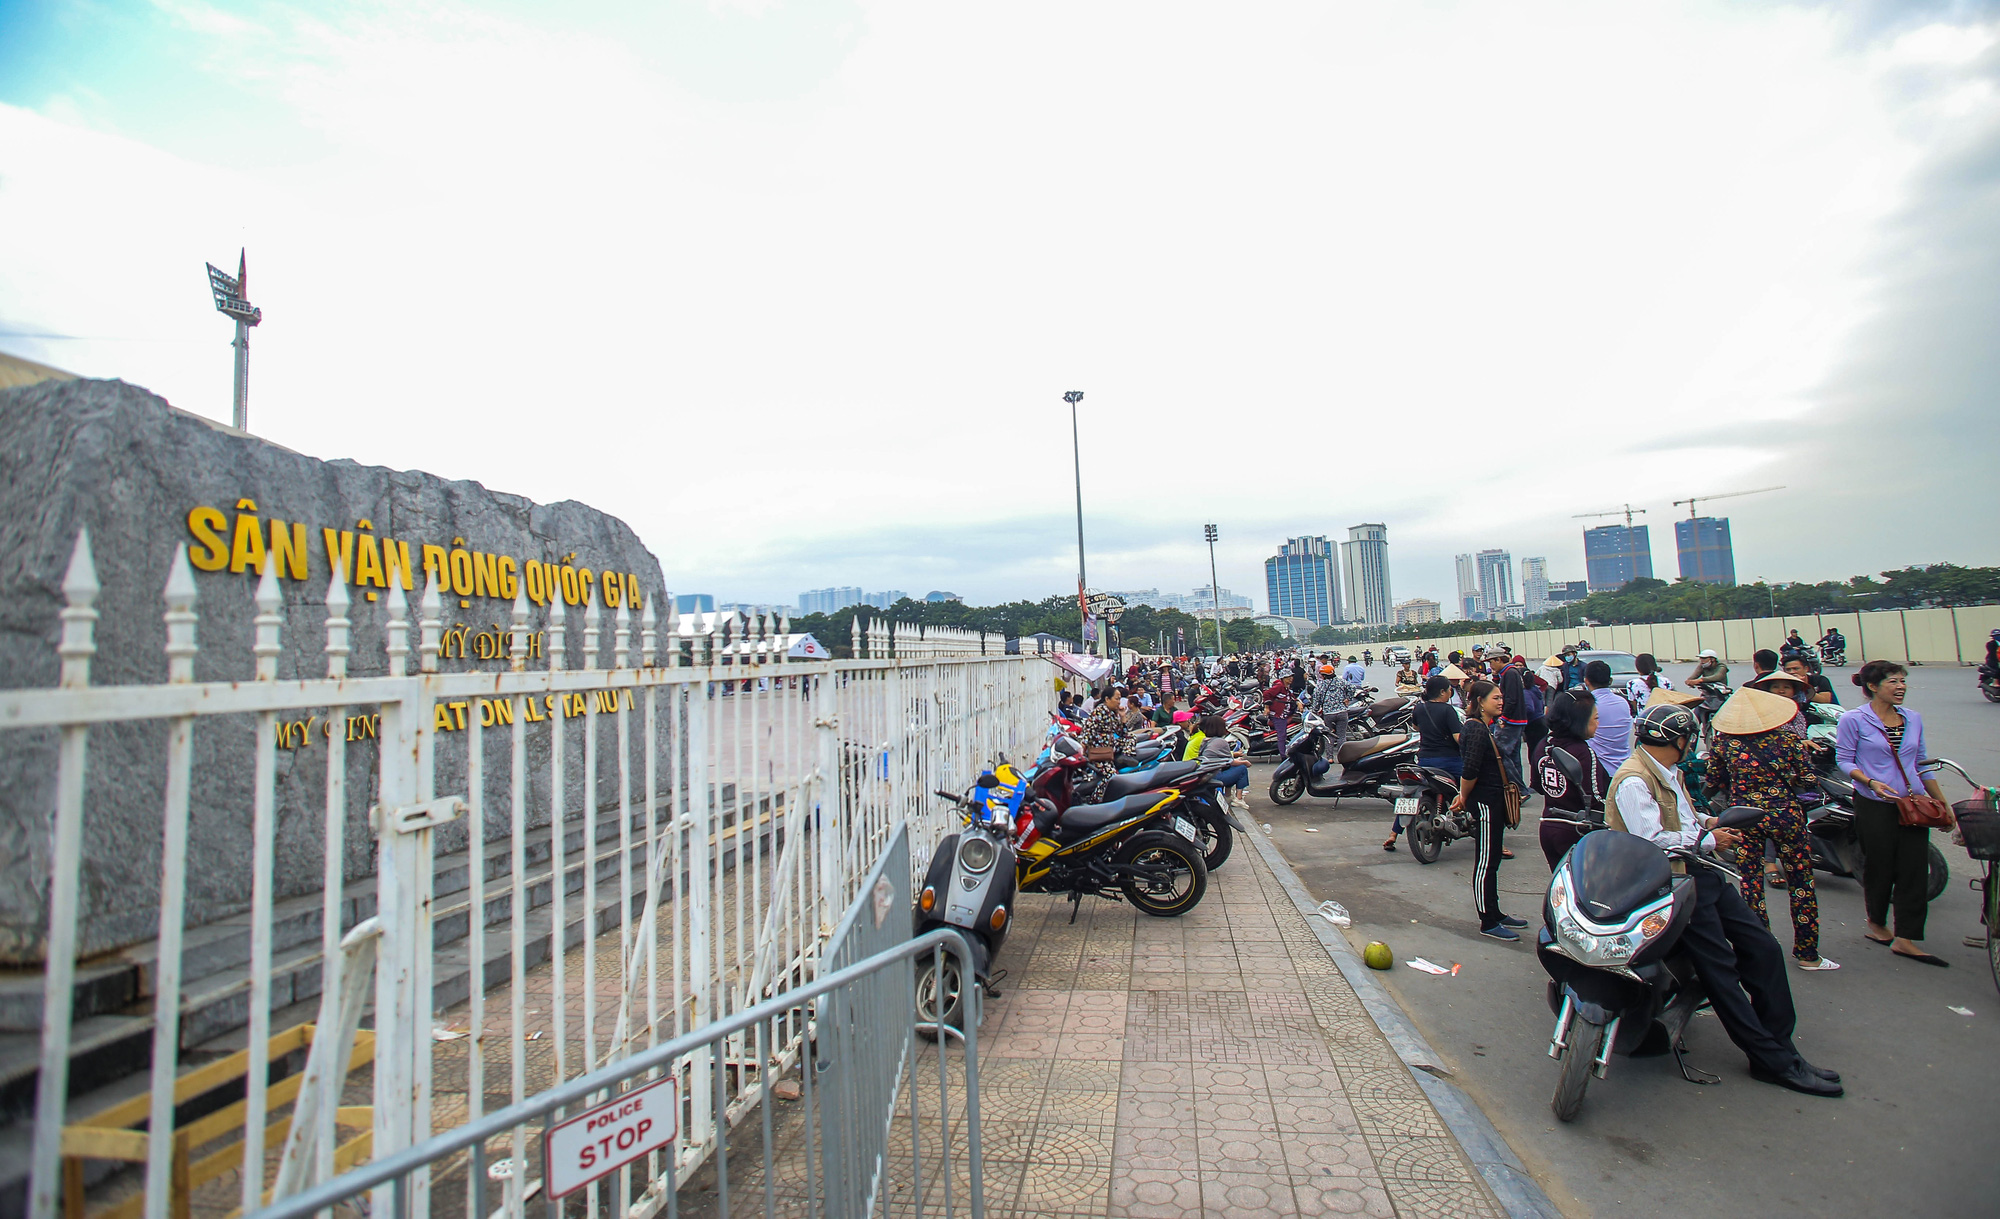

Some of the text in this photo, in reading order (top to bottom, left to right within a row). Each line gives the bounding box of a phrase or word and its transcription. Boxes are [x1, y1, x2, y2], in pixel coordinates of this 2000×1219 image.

[188, 498, 643, 609] SÂN VẬN ĐỘNG QUỐC GIA
[274, 713, 383, 749] MY IN
[428, 696, 545, 733] ATONL
[1589, 899, 1612, 911] HONDA
[586, 1098, 643, 1133] POLICE
[578, 1118, 653, 1170] STOP
